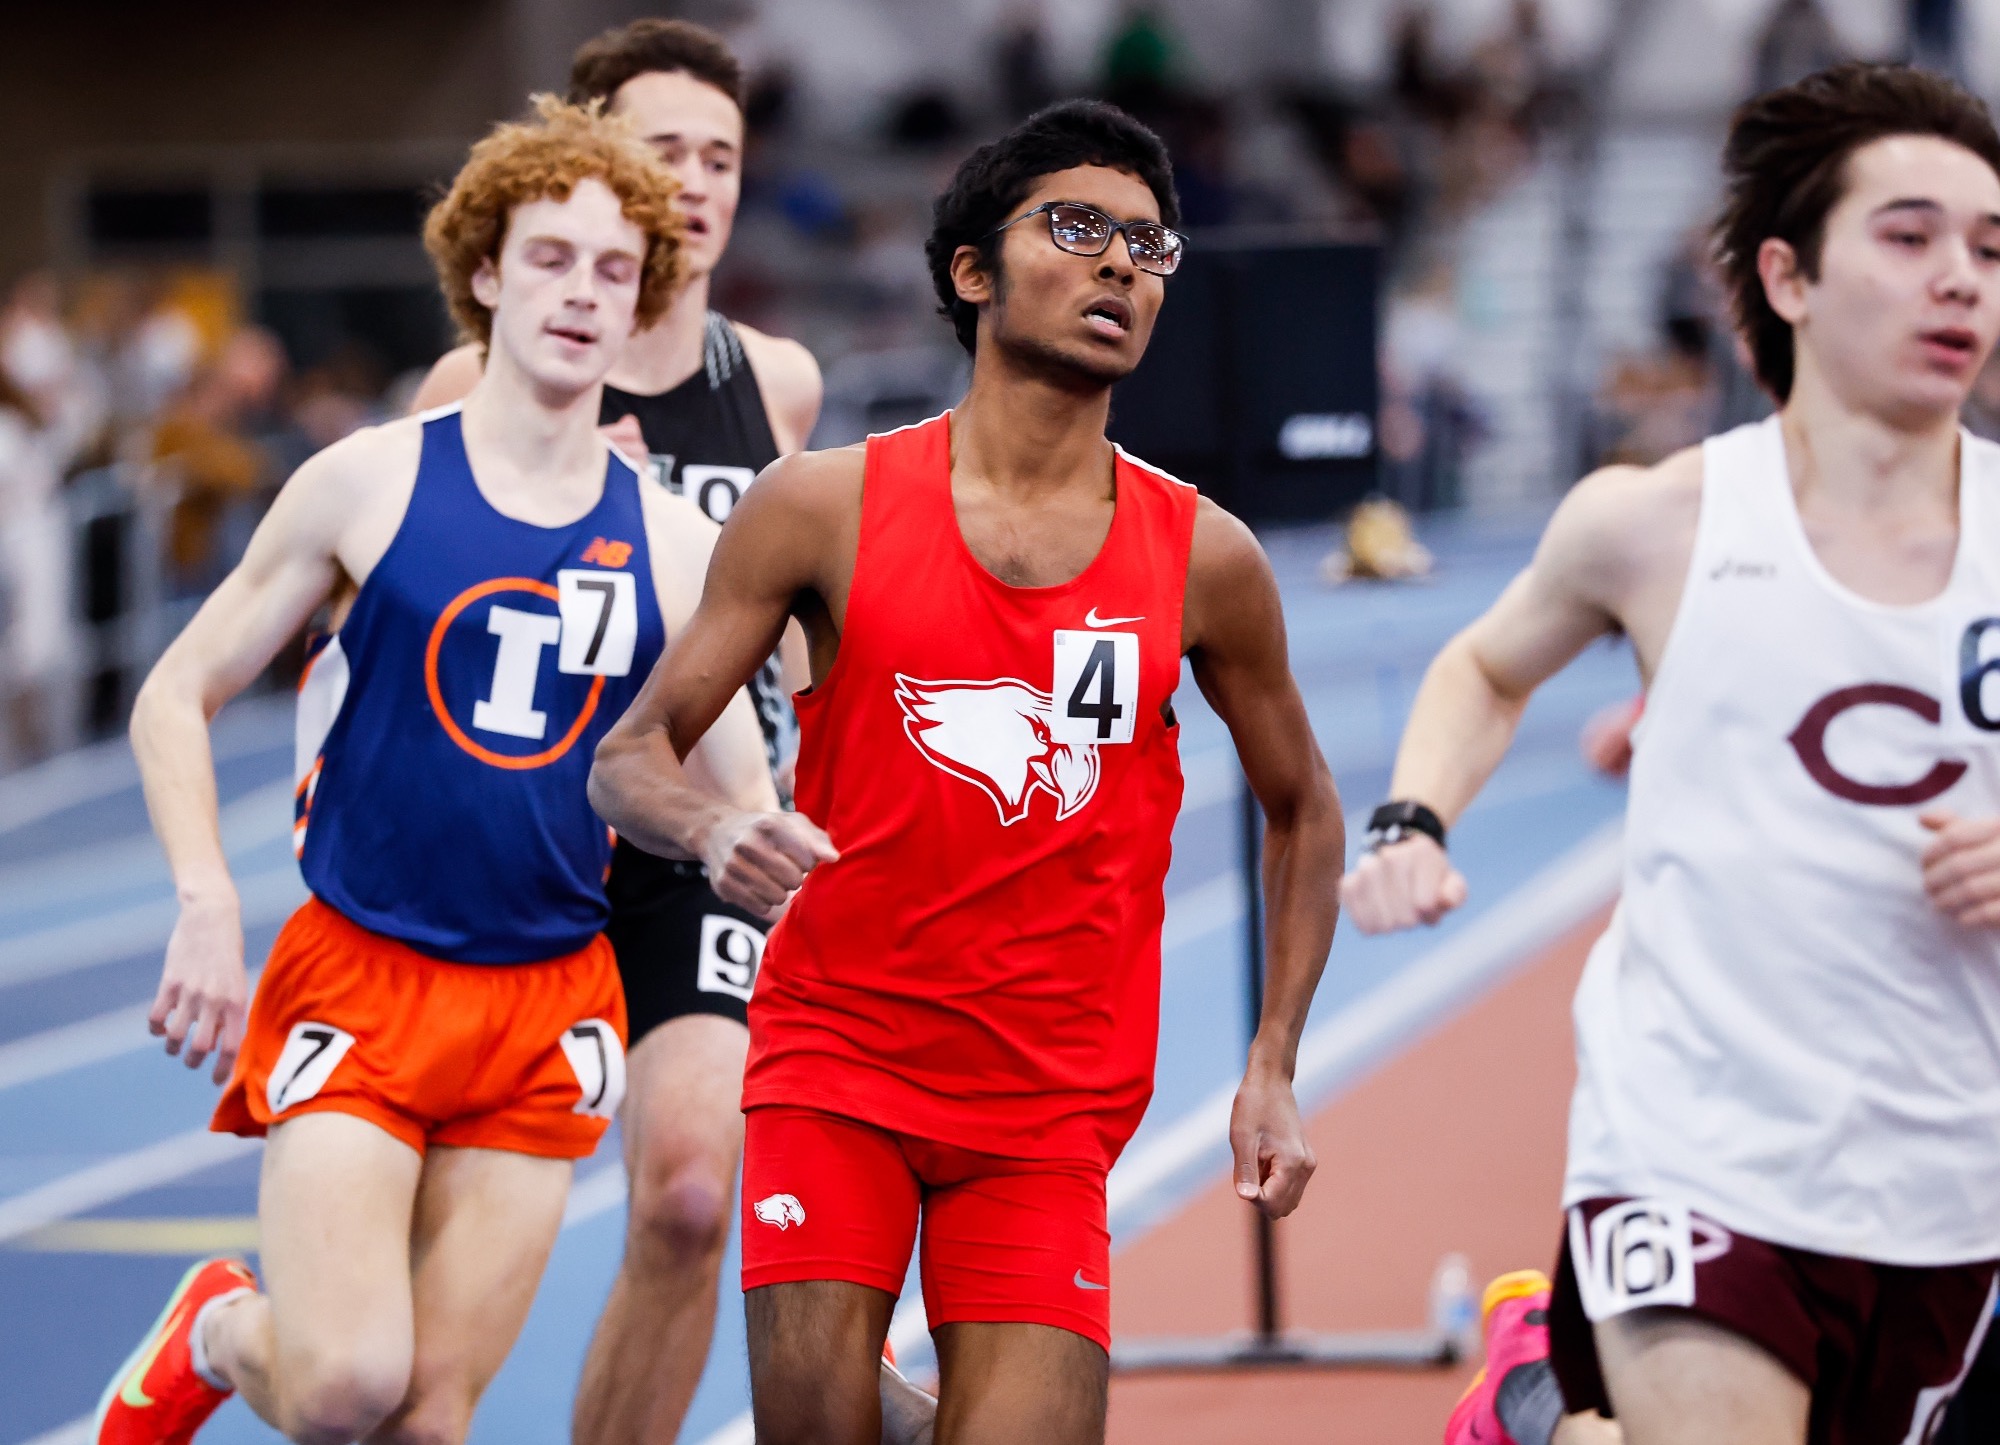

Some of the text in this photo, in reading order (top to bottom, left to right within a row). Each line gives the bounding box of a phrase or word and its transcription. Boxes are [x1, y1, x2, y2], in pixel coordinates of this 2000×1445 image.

[580, 536, 633, 568] NB
[576, 579, 615, 666] 7
[473, 604, 562, 740] I
[1067, 639, 1123, 739] 4
[1958, 617, 2000, 732] 6
[1786, 682, 1969, 807] C
[716, 929, 757, 990] 9
[278, 1031, 336, 1105] 7
[571, 1026, 607, 1109] 7
[1607, 1212, 1676, 1295] 6
